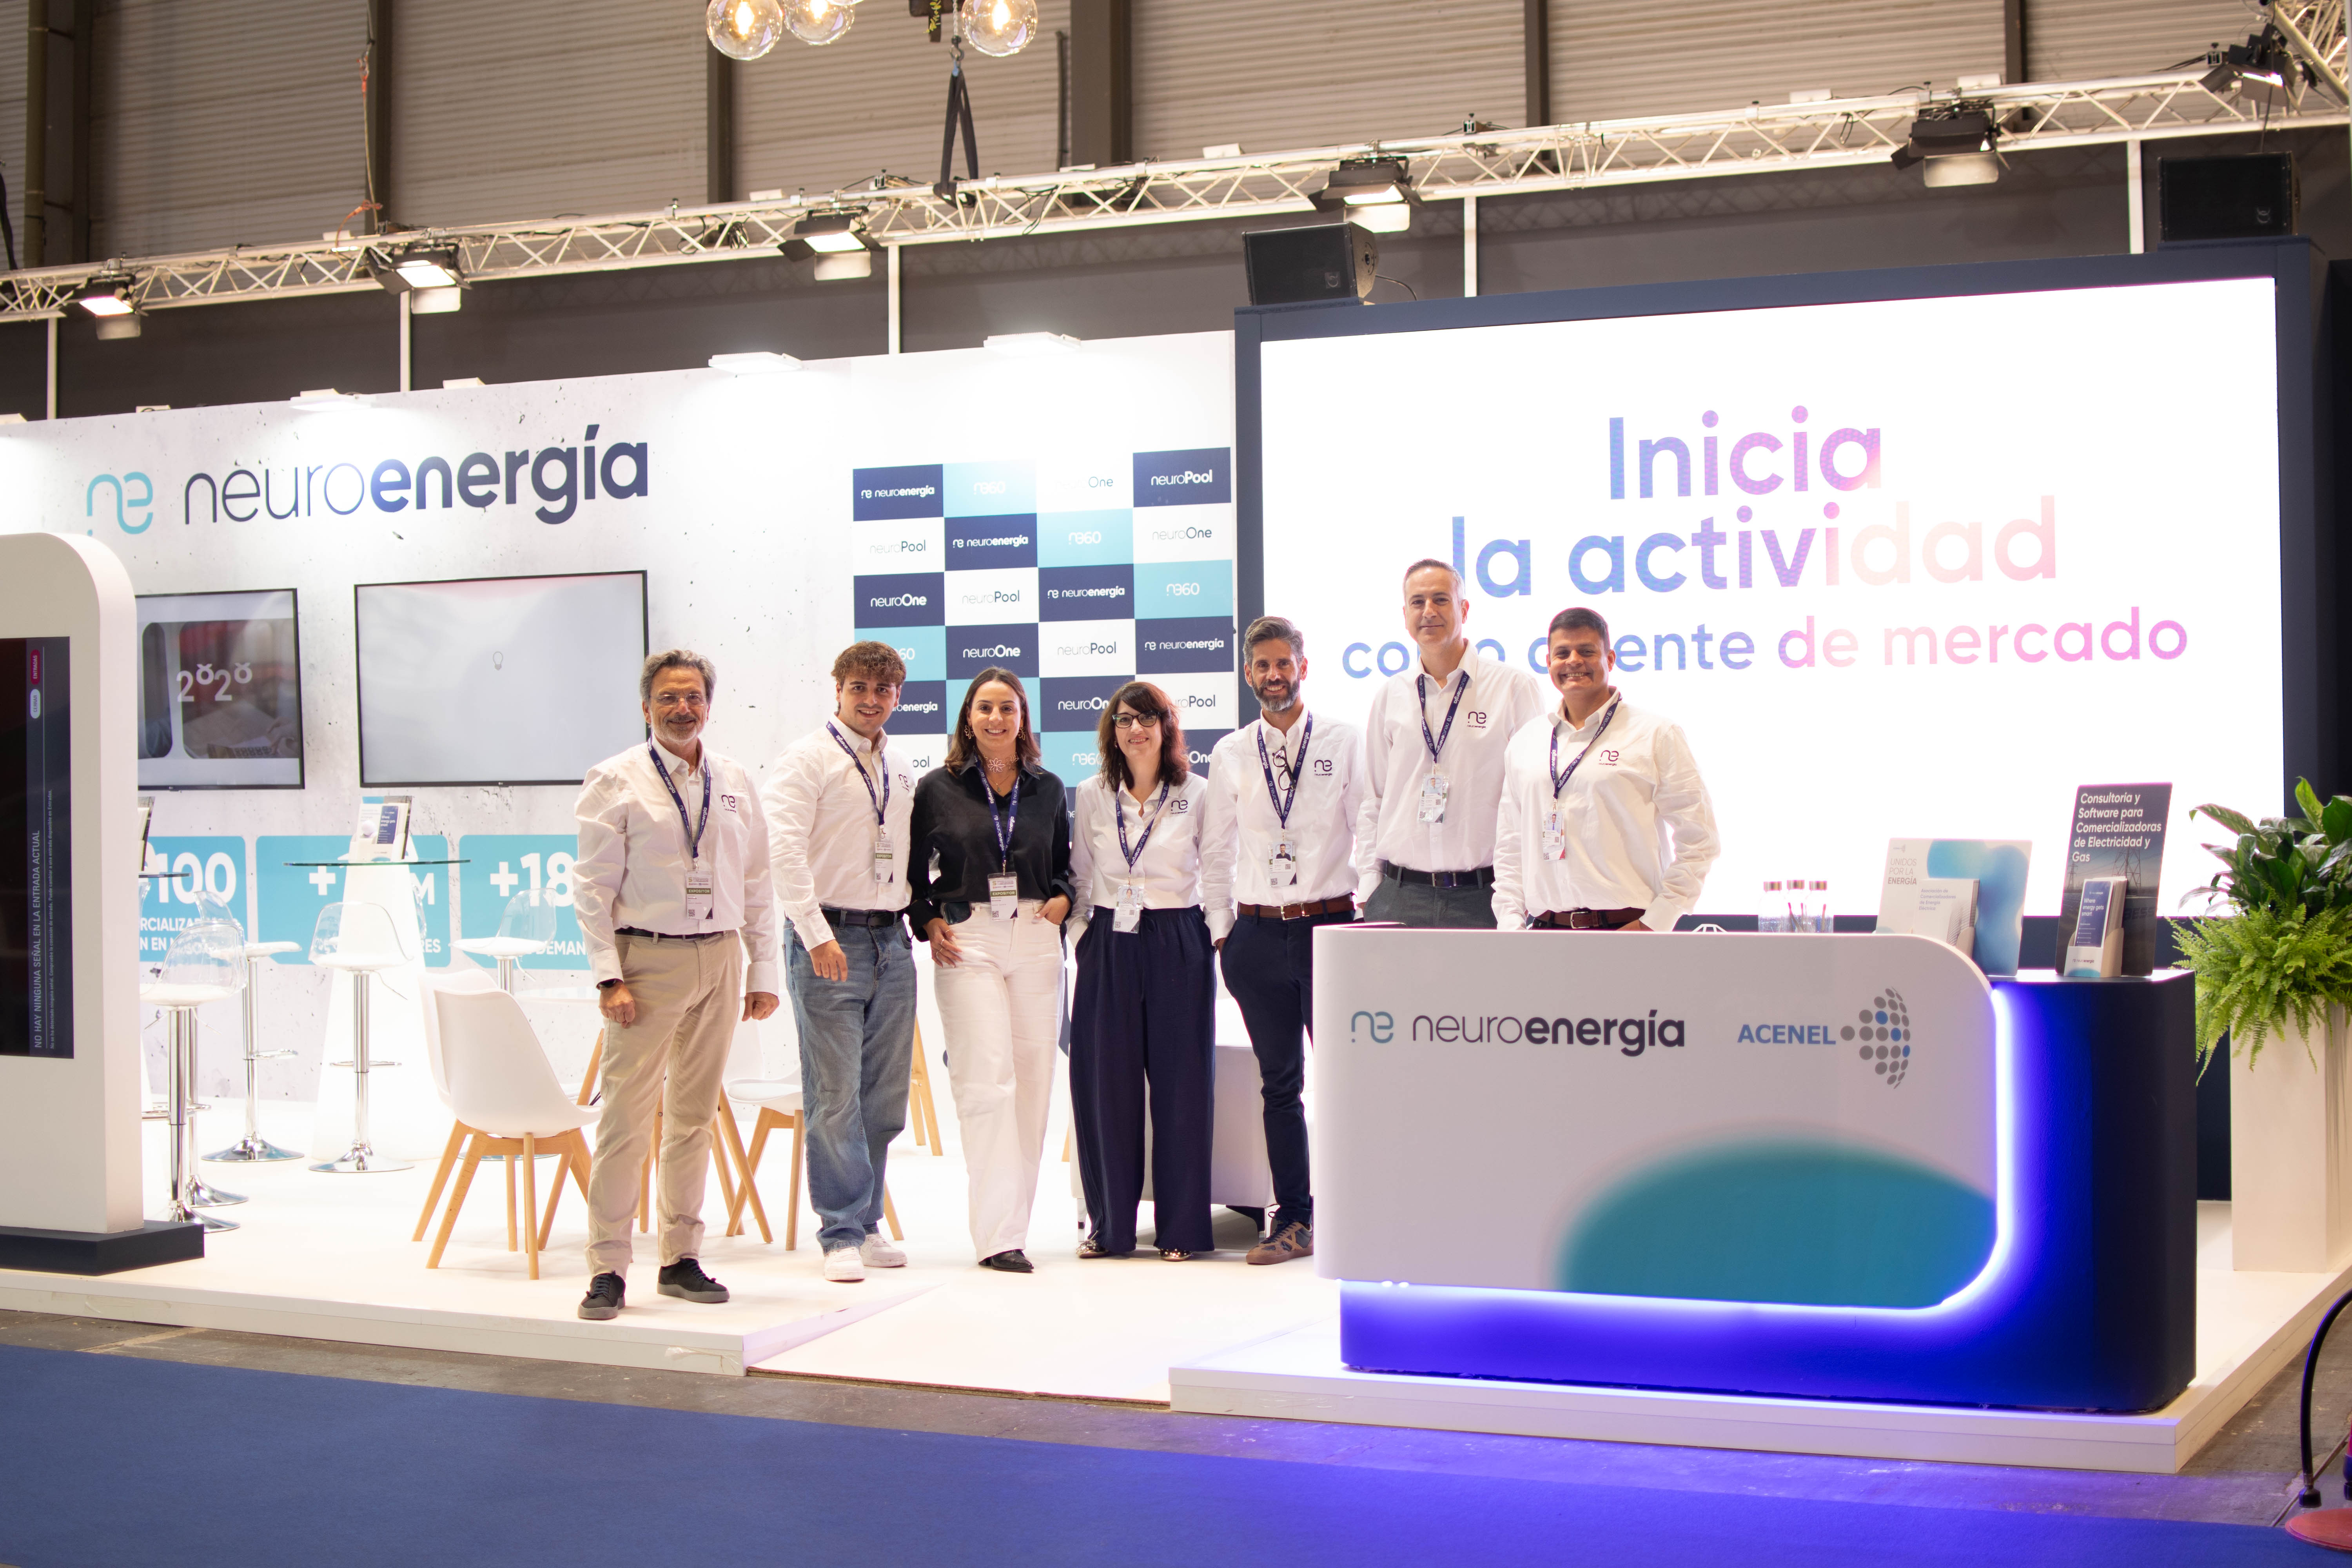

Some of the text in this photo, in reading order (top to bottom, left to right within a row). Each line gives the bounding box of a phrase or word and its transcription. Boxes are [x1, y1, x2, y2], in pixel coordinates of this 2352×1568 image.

[1609, 405, 1882, 500] Inicia
[185, 425, 648, 524] neuroenergía
[1151, 469, 1213, 486] neuroPool
[875, 485, 935, 498] neuroenergía
[967, 534, 1029, 548] neuroenergía
[1152, 527, 1212, 541] neuroOne
[869, 539, 926, 554] neuroPool
[1452, 495, 2056, 598] la actividad
[962, 590, 1020, 604] neuroPool
[1062, 585, 1125, 599] neuroenergía
[870, 593, 927, 607] neuroOne
[1057, 641, 1117, 656] neuroPool
[1159, 637, 1224, 651] neuroenergía
[1342, 639, 1506, 679] coo
[1778, 615, 1858, 669] de
[1884, 606, 2187, 666] mercado
[963, 644, 1021, 658] neuroOne
[1454, 676, 1467, 704] neuroenergía
[895, 702, 938, 714] roenergía
[1058, 697, 1109, 710] neuroOn
[1436, 722, 1449, 753] neuroenergía
[1258, 740, 1269, 769] neuroenergía
[1299, 732, 1309, 763] neuroenergía
[659, 766, 676, 793] neuroenergía
[1557, 760, 1577, 788] neuroenergía
[983, 778, 994, 804] neuroenergía
[2080, 792, 2141, 805] Consultoría y
[1270, 787, 1282, 817] neuroenergía
[2078, 807, 2143, 820] Software para
[2076, 821, 2162, 833] Comercializadoras
[996, 822, 1004, 851] neuroenergía
[2074, 836, 2151, 849] de Electricidad y
[1131, 836, 1146, 864] neuroenergía
[2072, 851, 2091, 862] Gas
[155, 852, 236, 904] 100
[1888, 876, 1917, 885] ENERGÍA
[33, 911, 40, 921] LA
[33, 924, 40, 936] EN
[32, 939, 41, 967] SEÑAL
[1412, 1009, 1685, 1057] neuroenergía
[1737, 1024, 1837, 1045] ACENEL
[34, 1035, 42, 1047] NO
